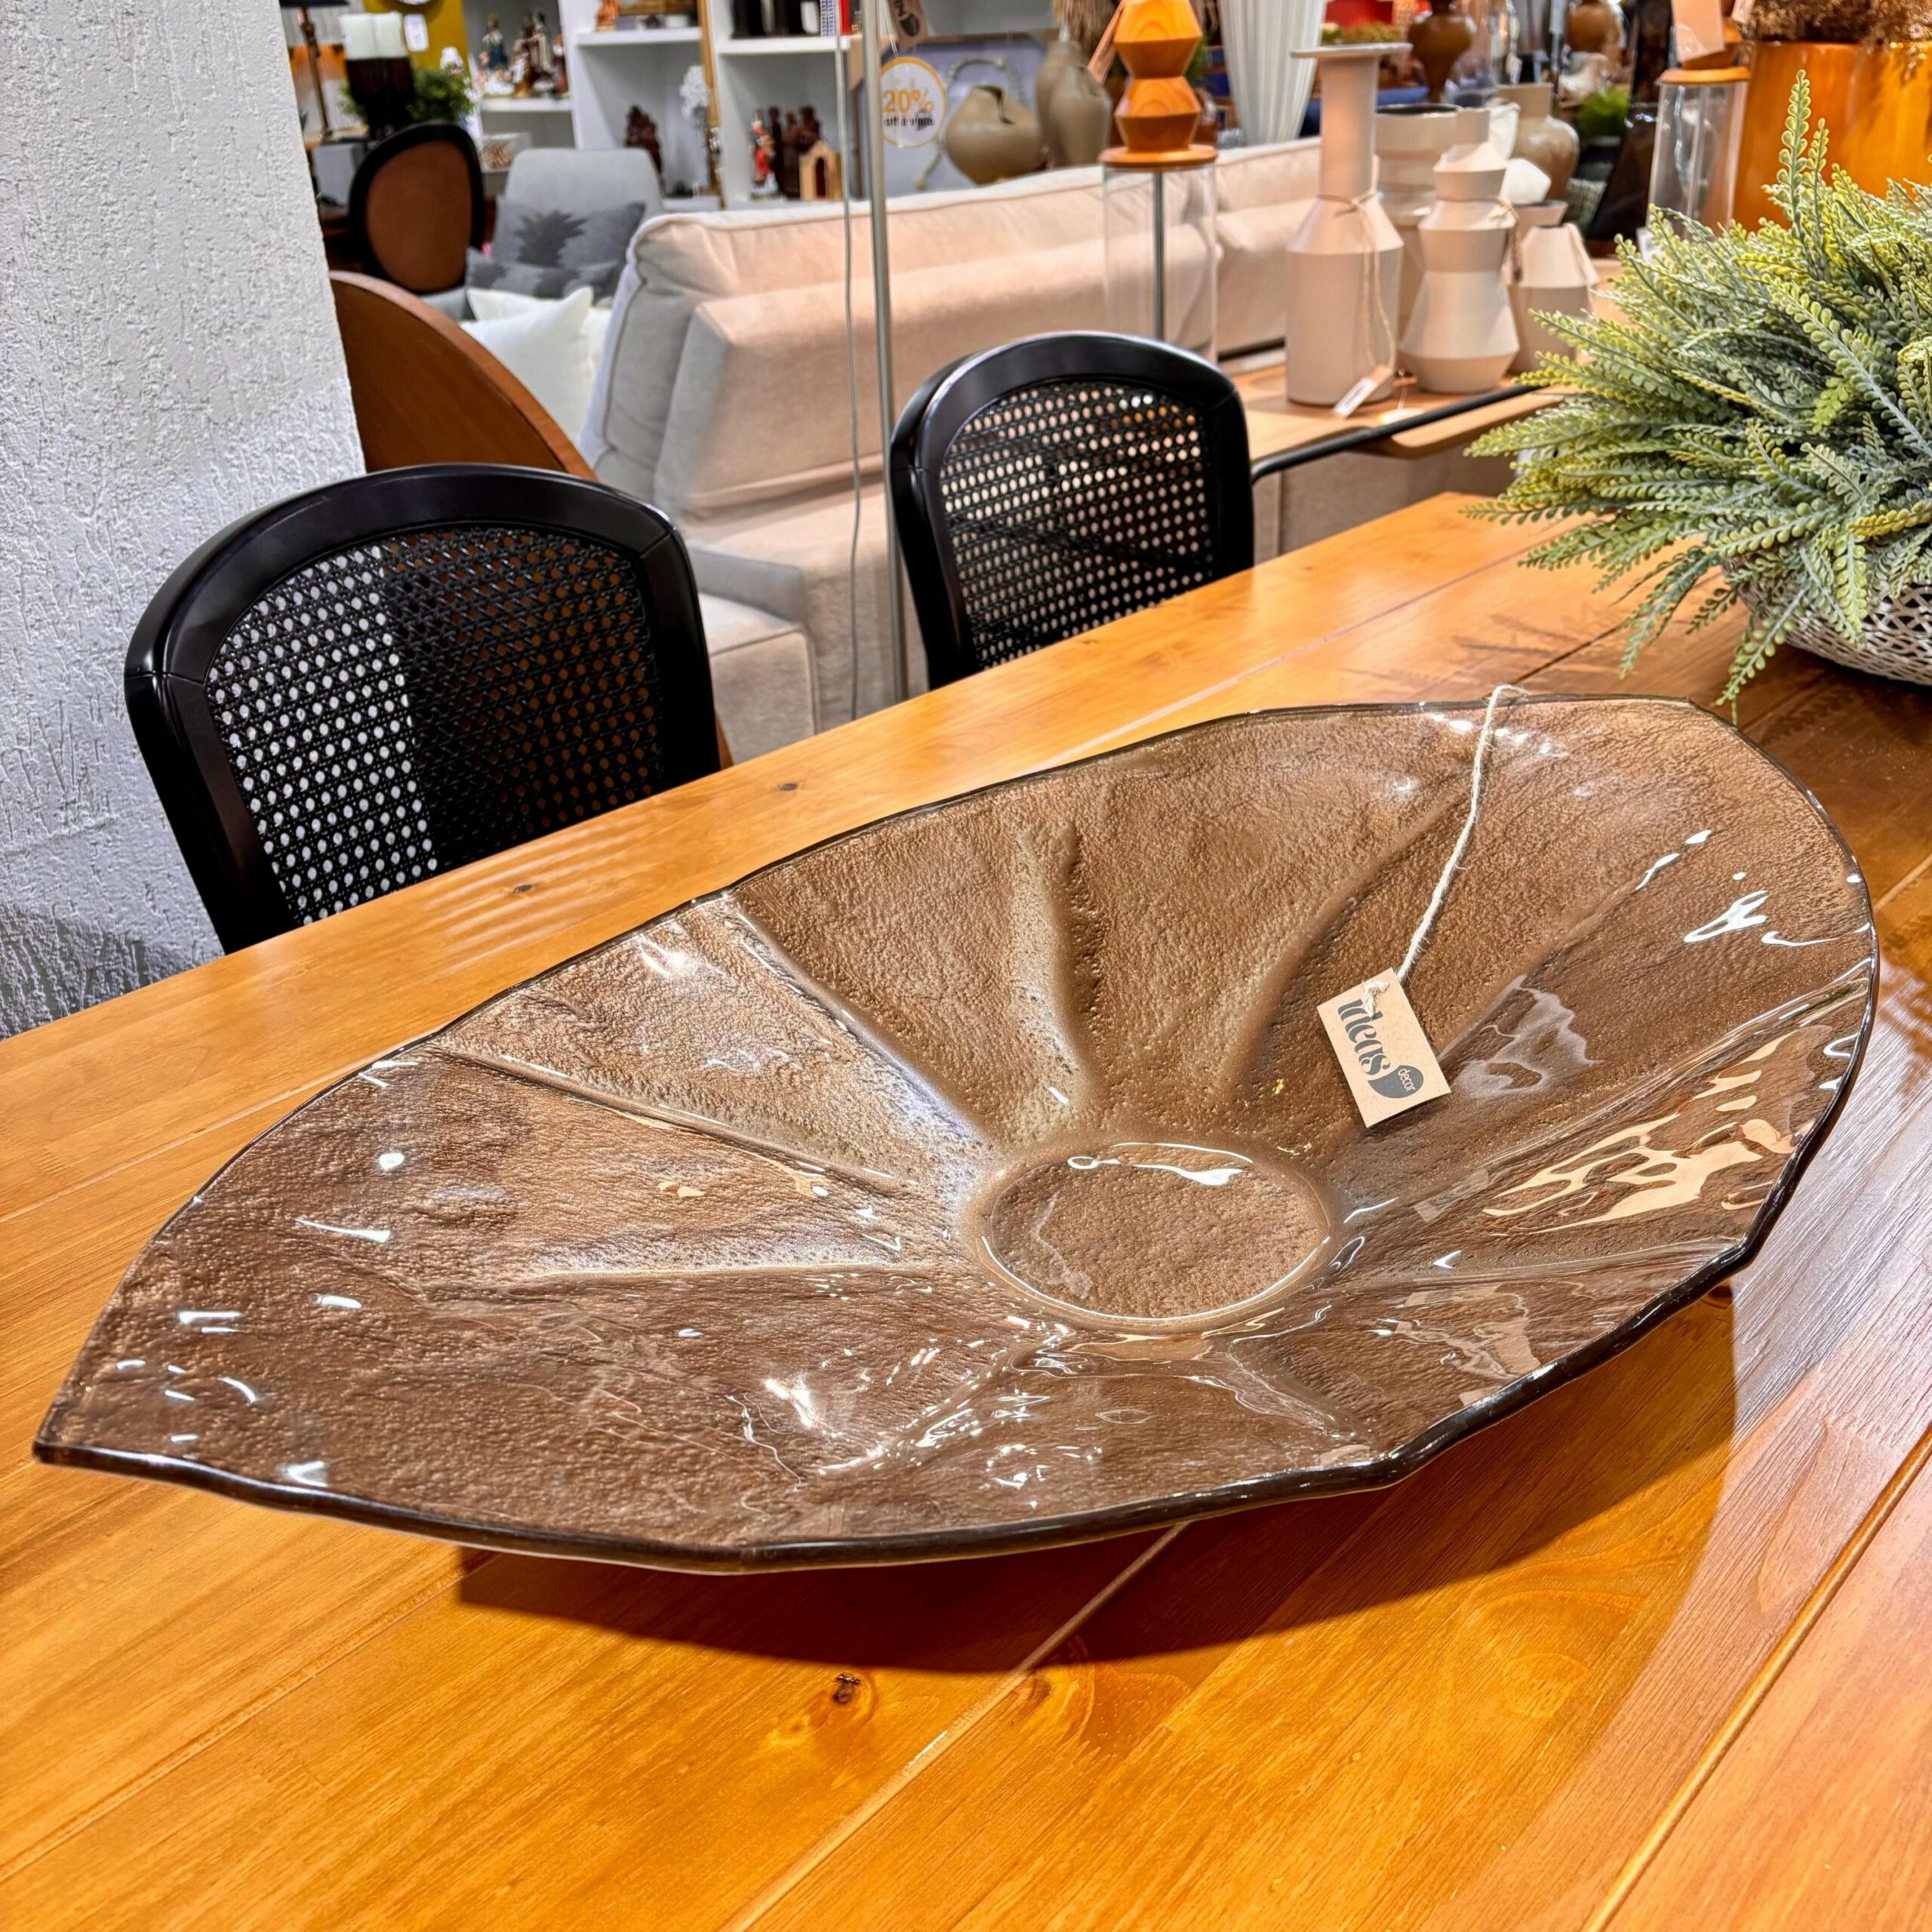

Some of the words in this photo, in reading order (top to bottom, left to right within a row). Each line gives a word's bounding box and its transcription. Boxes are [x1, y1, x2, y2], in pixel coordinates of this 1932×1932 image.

[882, 88, 934, 113] 20%
[1337, 998, 1391, 1075] ideas
[1398, 1068, 1416, 1092] decor
